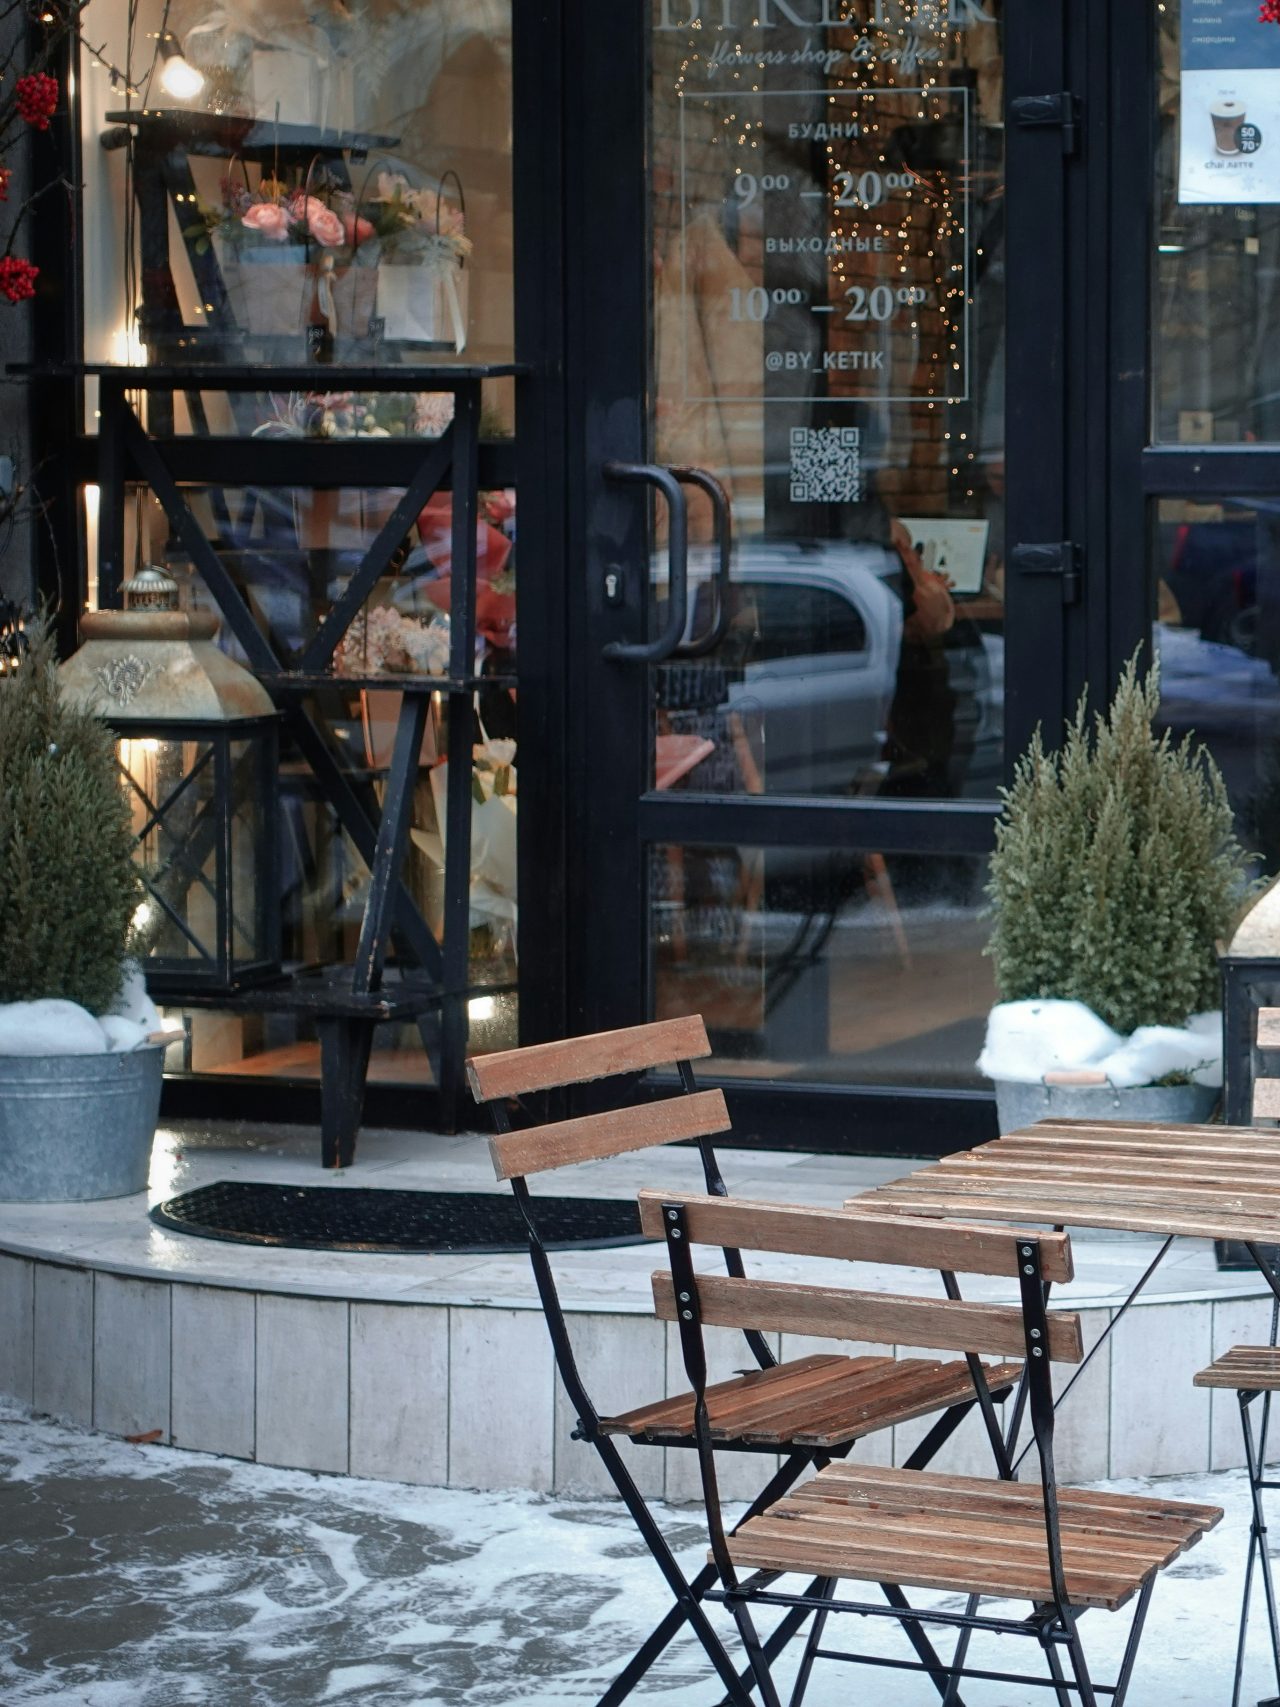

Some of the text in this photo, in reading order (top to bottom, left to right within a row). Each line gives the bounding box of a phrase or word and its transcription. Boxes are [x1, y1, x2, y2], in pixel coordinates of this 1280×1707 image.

[706, 40, 786, 78] flowers
[790, 39, 843, 73] shop
[880, 36, 940, 73] coffee
[788, 122, 859, 139] БУДНИ
[1241, 127, 1255, 137] 50
[765, 236, 884, 255] ВЫХОДНЫЕ
[765, 351, 884, 373] @BY_KETIK
